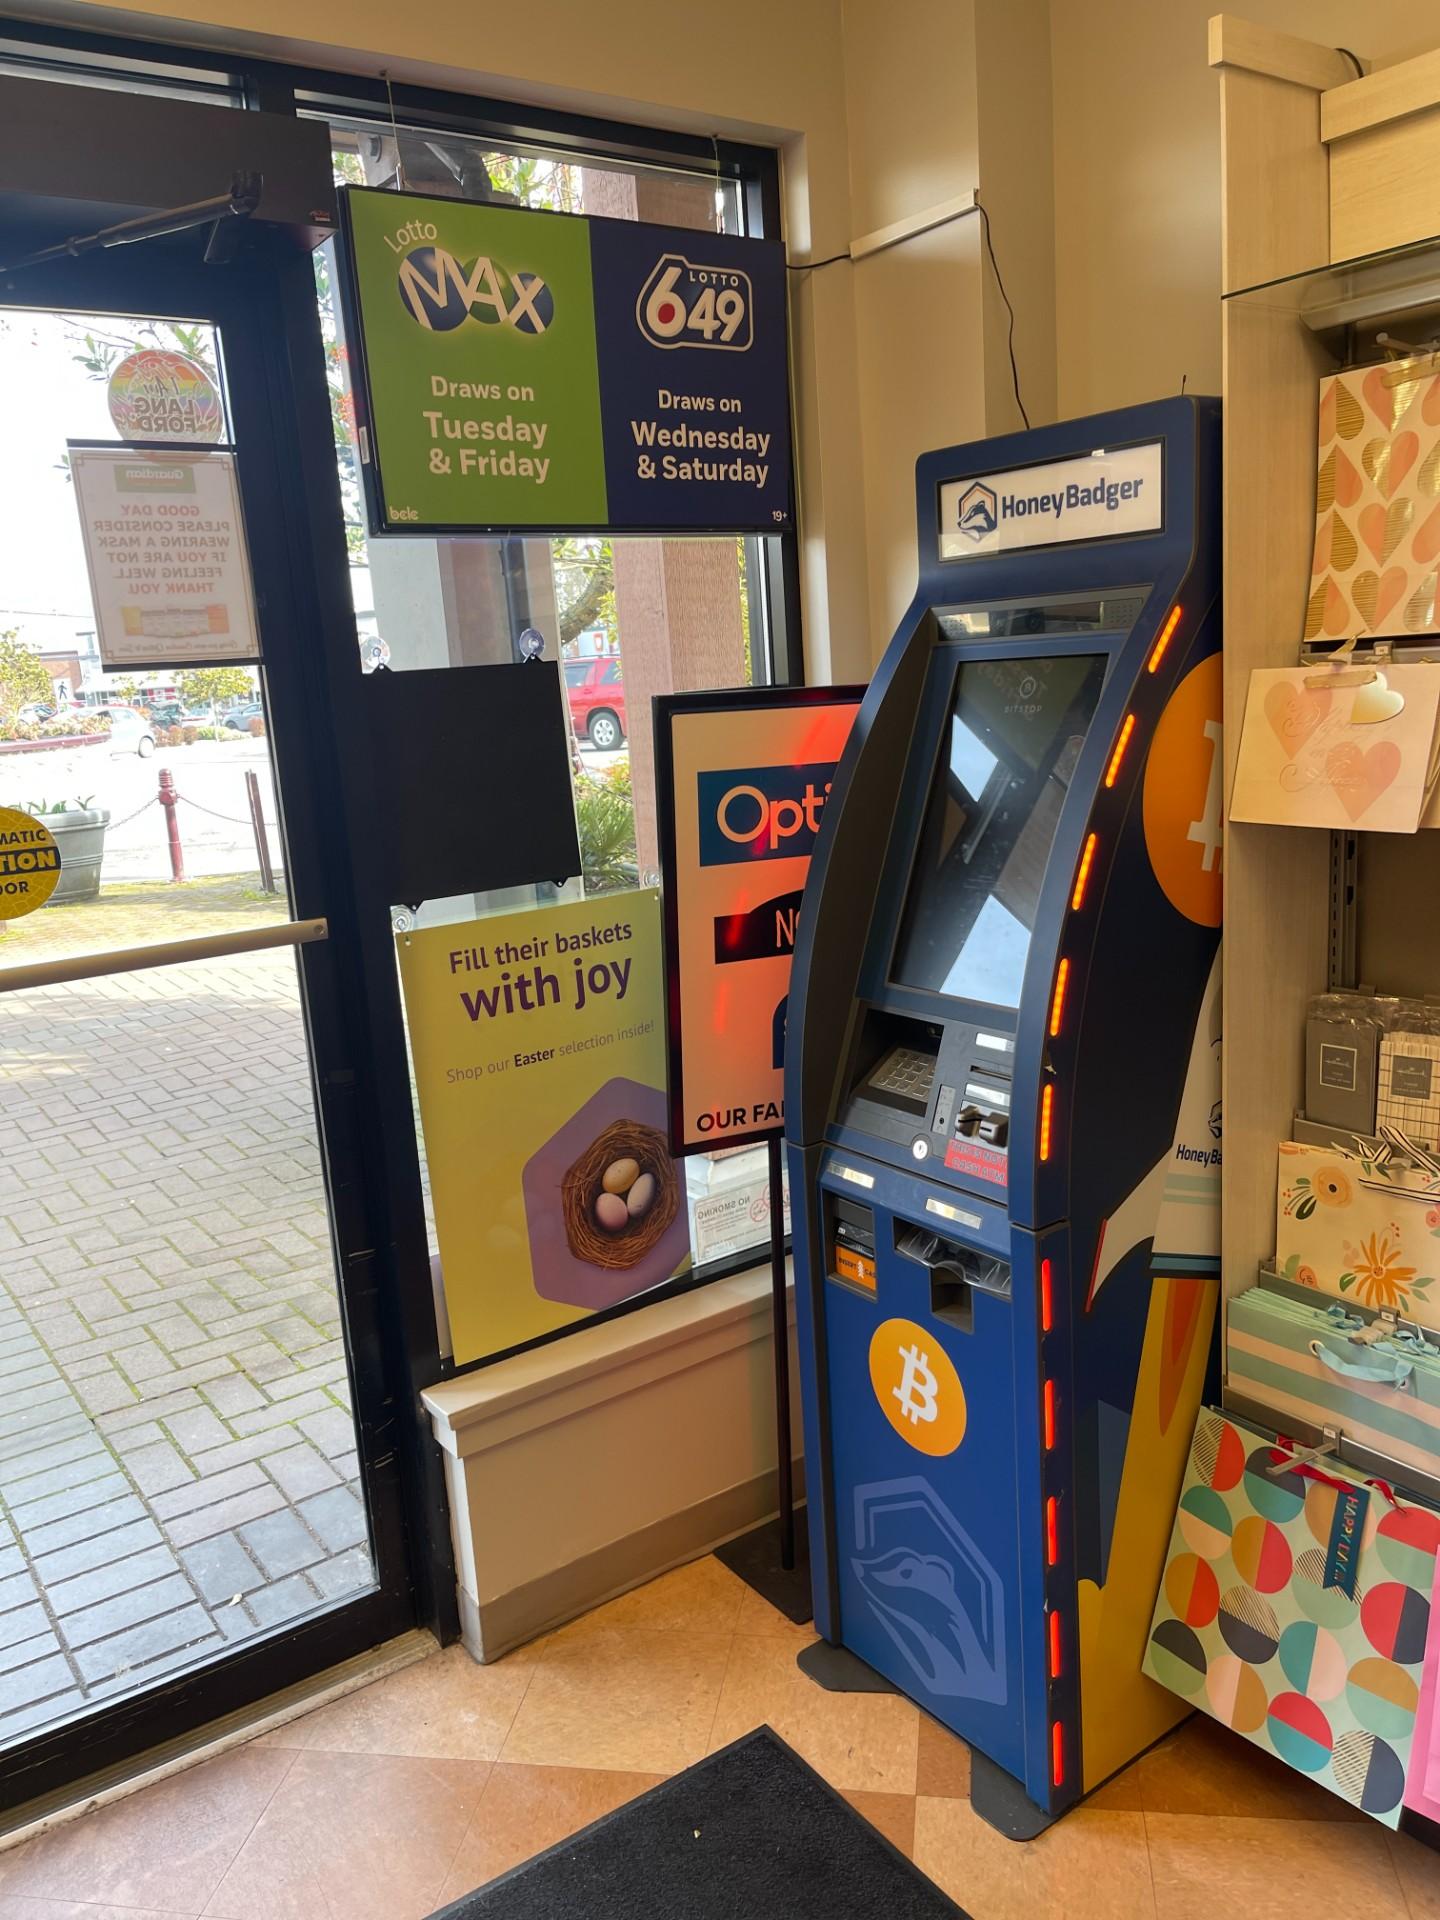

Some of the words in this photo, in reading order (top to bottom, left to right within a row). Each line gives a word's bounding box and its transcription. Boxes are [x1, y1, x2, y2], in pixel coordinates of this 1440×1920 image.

[383, 219, 438, 254] Lotto
[399, 246, 548, 335] MAX
[689, 269, 740, 287] LOTTO
[430, 375, 501, 401] Draws
[507, 385, 535, 402] on
[657, 389, 715, 412] Draws
[719, 397, 742, 413] on
[422, 410, 548, 449] Tuesday
[630, 420, 771, 457] Wednesday
[428, 448, 452, 475] &
[459, 449, 551, 484] Friday
[637, 455, 657, 479] &
[661, 455, 769, 489] Saturday
[771, 509, 789, 522] 19+
[1001, 477, 1144, 519] HoneyBadger
[775, 908, 800, 948] N
[449, 947, 490, 974] Fill
[495, 937, 549, 966] their
[555, 922, 633, 954] baskets
[460, 966, 561, 1022] with
[573, 957, 633, 1010] joy
[446, 1064, 484, 1084] Shop
[487, 1058, 511, 1074] our
[514, 1049, 556, 1068] Easter
[559, 1032, 615, 1057] selection
[617, 1020, 655, 1041] inside!
[696, 1107, 747, 1132] OUR
